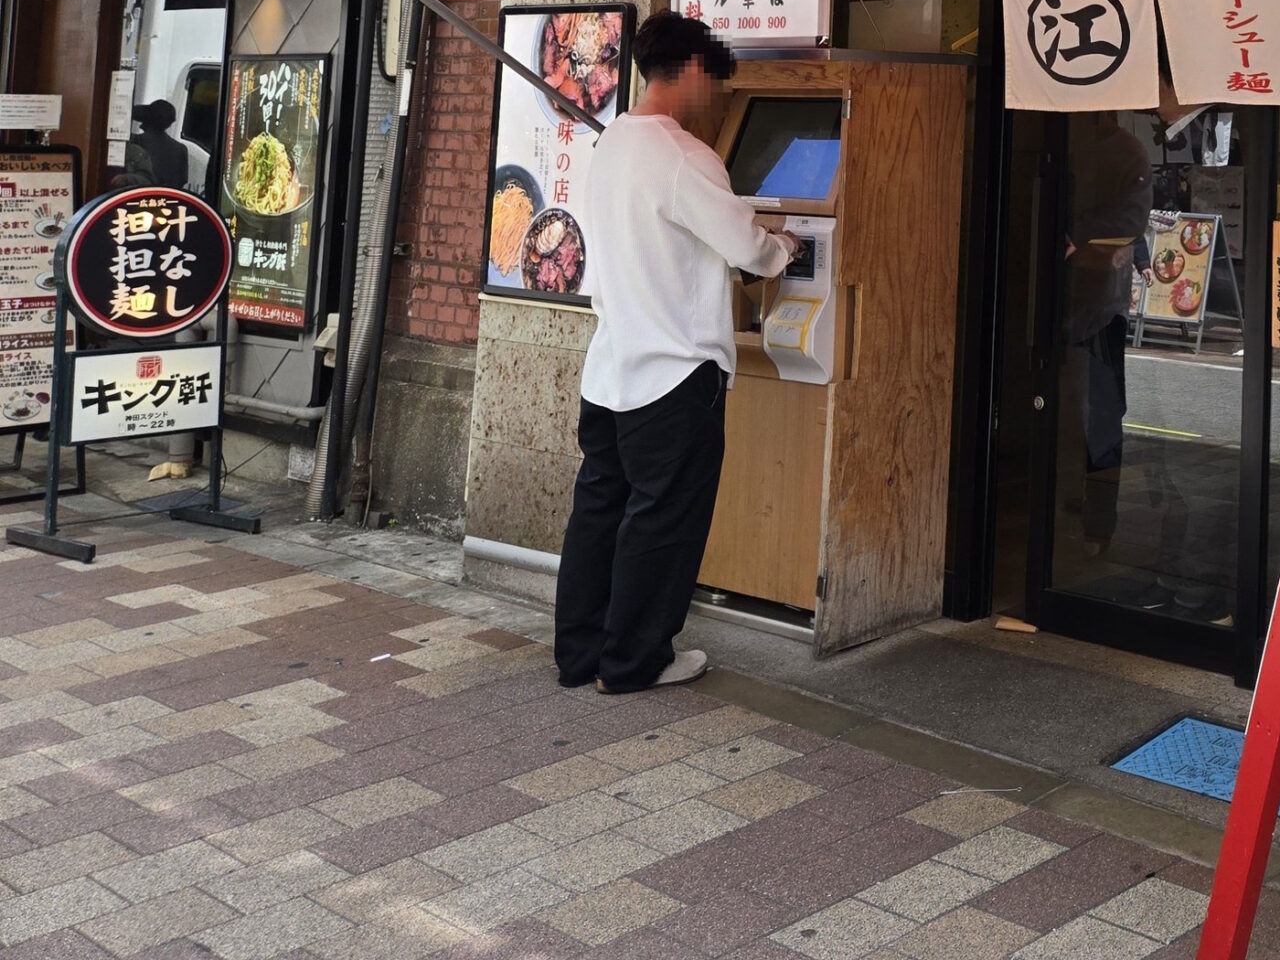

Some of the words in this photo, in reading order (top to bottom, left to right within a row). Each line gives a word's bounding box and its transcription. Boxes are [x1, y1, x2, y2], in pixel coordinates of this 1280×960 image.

[712, 16, 730, 30] 650
[737, 16, 761, 30] 1000
[767, 16, 787, 30] 900
[553, 120, 575, 204] 味の店
[0, 221, 29, 230] るまで
[109, 207, 158, 321] 担担麺
[156, 205, 198, 318] 汁なし
[81, 372, 212, 415] キング軒
